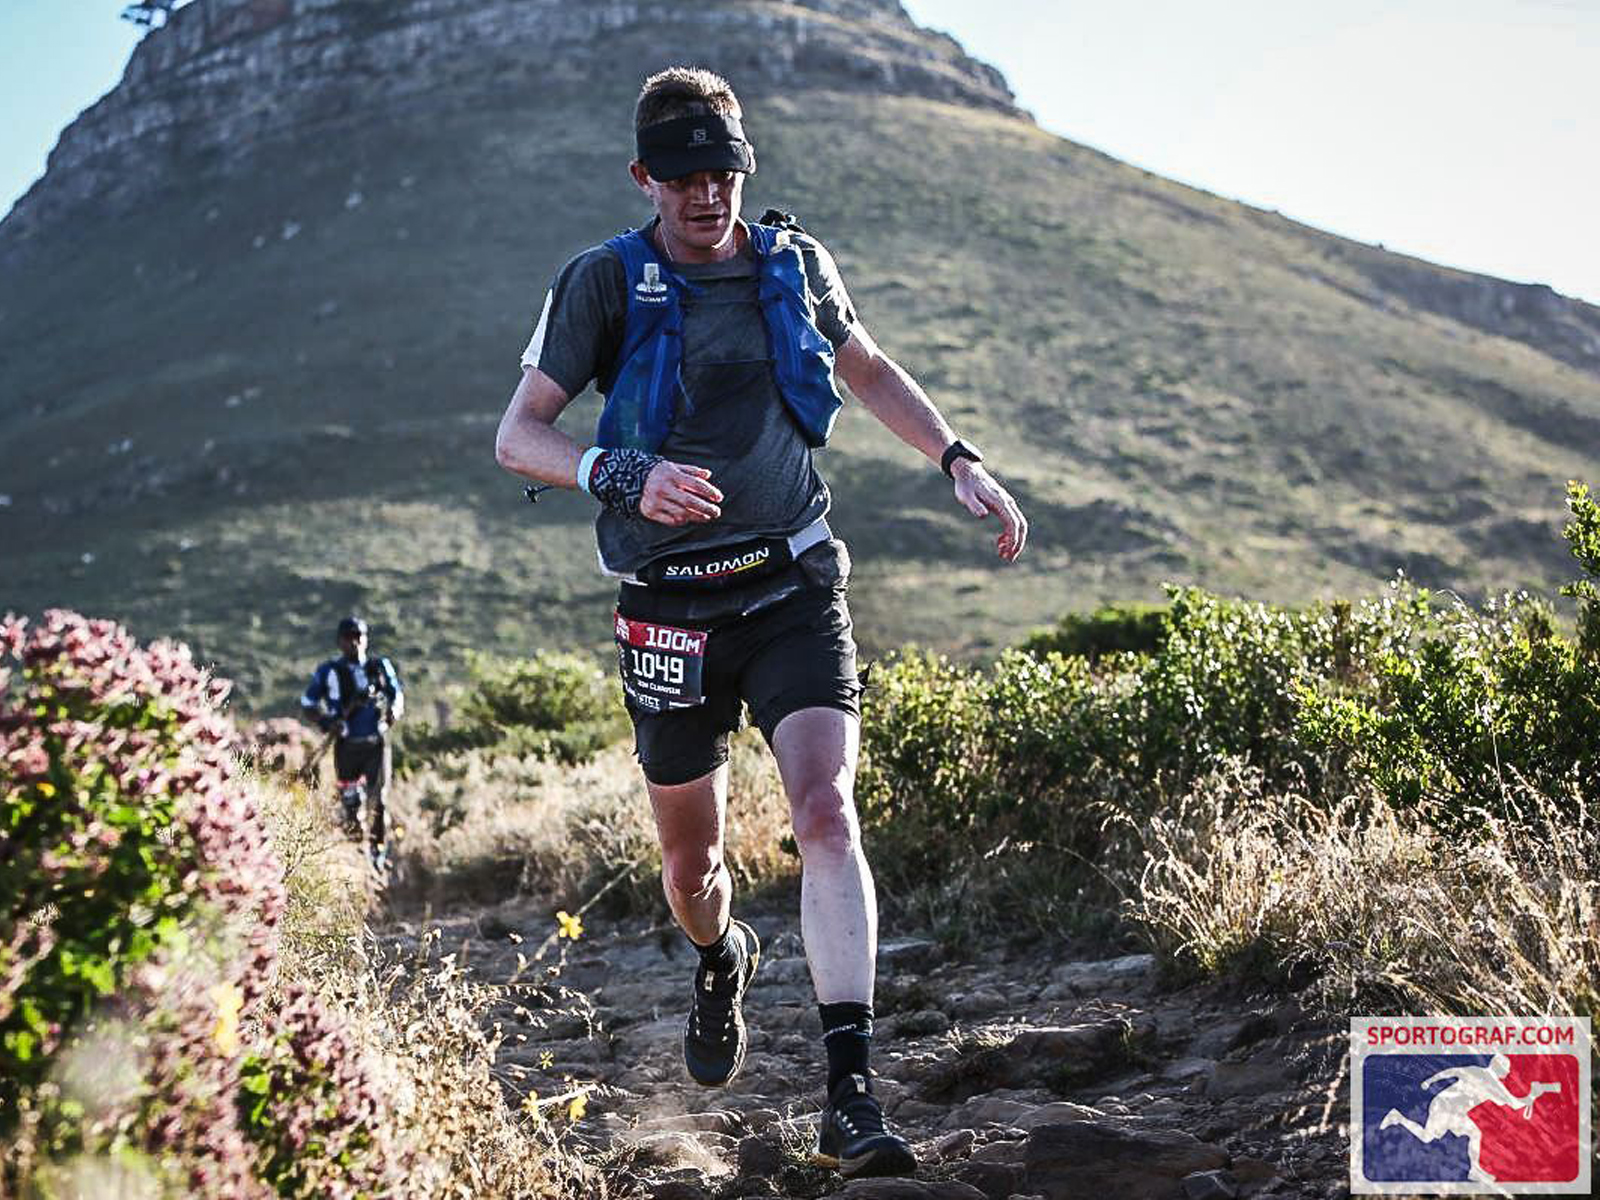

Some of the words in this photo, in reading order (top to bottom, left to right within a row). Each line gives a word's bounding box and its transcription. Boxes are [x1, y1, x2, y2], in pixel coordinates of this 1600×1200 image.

[665, 547, 769, 576] SALOMON
[645, 626, 700, 653] 100M
[631, 649, 684, 684] 1049
